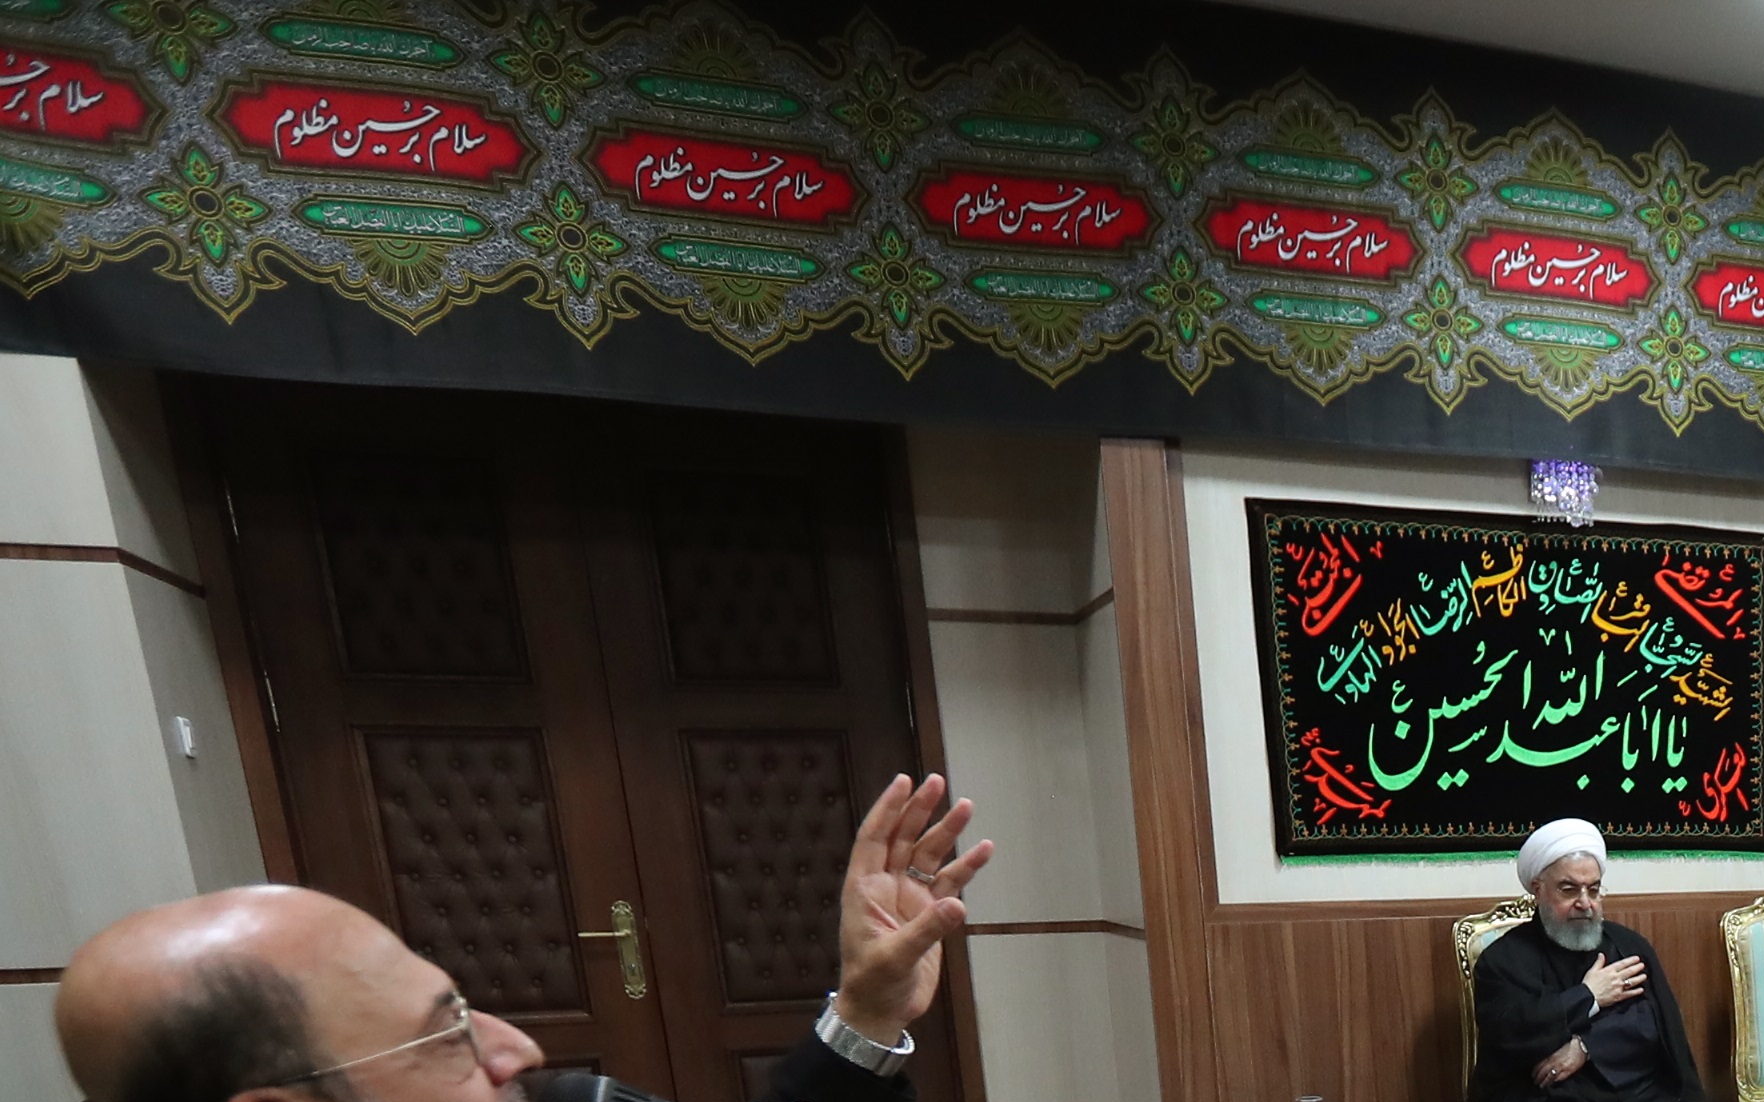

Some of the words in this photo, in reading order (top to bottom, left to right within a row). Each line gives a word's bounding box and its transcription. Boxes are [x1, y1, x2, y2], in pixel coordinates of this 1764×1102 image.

[38, 81, 104, 132] سلام
[274, 99, 339, 159] مظلوم
[399, 132, 422, 164] بر
[429, 125, 486, 172] سلام
[635, 147, 694, 200] مظلوم
[746, 180, 766, 209] بر
[772, 175, 824, 217] سلام
[954, 184, 1006, 237] مظلوم
[1051, 211, 1069, 239] بر
[1075, 204, 1121, 245] سلام
[1237, 213, 1285, 261] مظلوم
[1325, 240, 1342, 266] بر
[1346, 235, 1389, 273] سلام
[1492, 242, 1536, 287] مظلوم
[1571, 268, 1586, 293] بر
[1589, 263, 1628, 299] سلام
[1719, 275, 1759, 319] مظلوم
